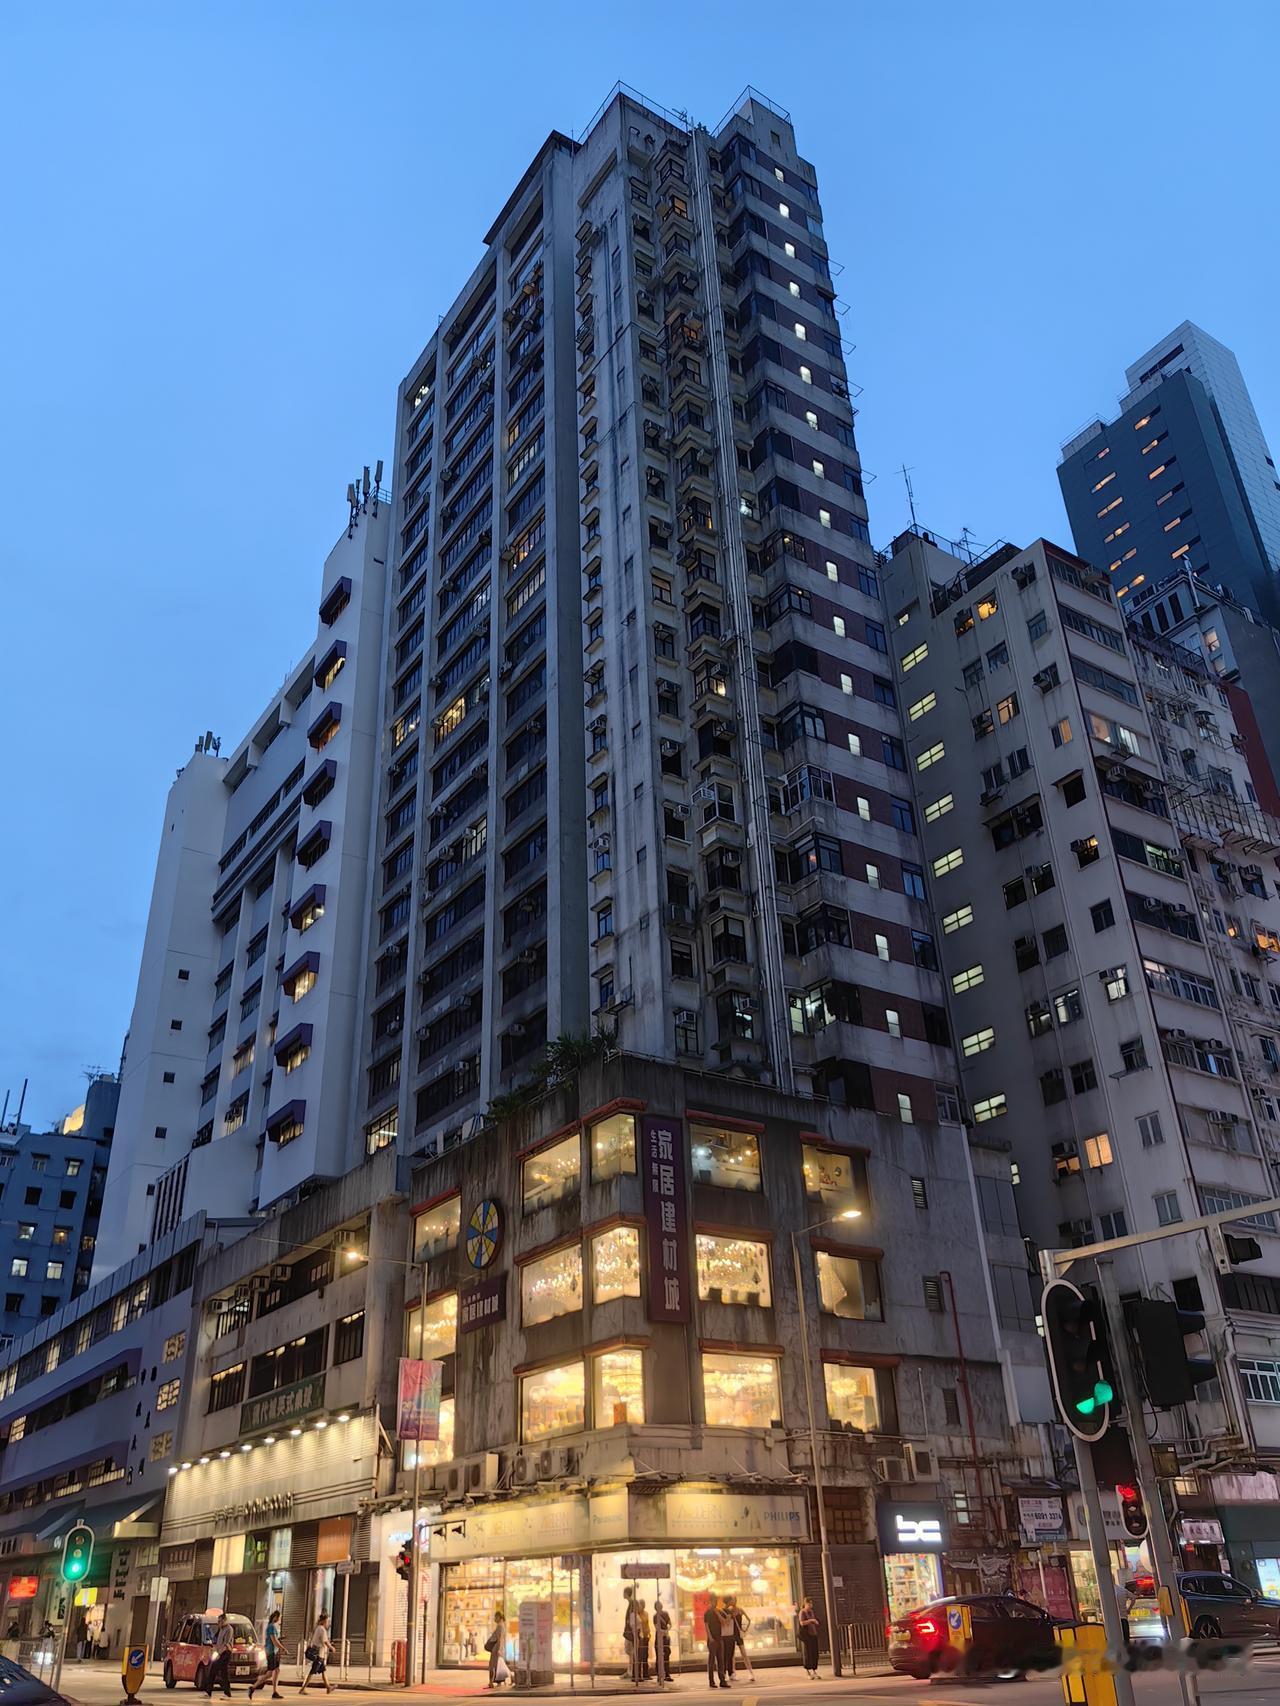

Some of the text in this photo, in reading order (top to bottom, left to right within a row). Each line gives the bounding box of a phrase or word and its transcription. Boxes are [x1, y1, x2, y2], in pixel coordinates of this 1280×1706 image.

[657, 1129, 680, 1311] 家居建材城
[763, 1511, 800, 1521] PHILIPS
